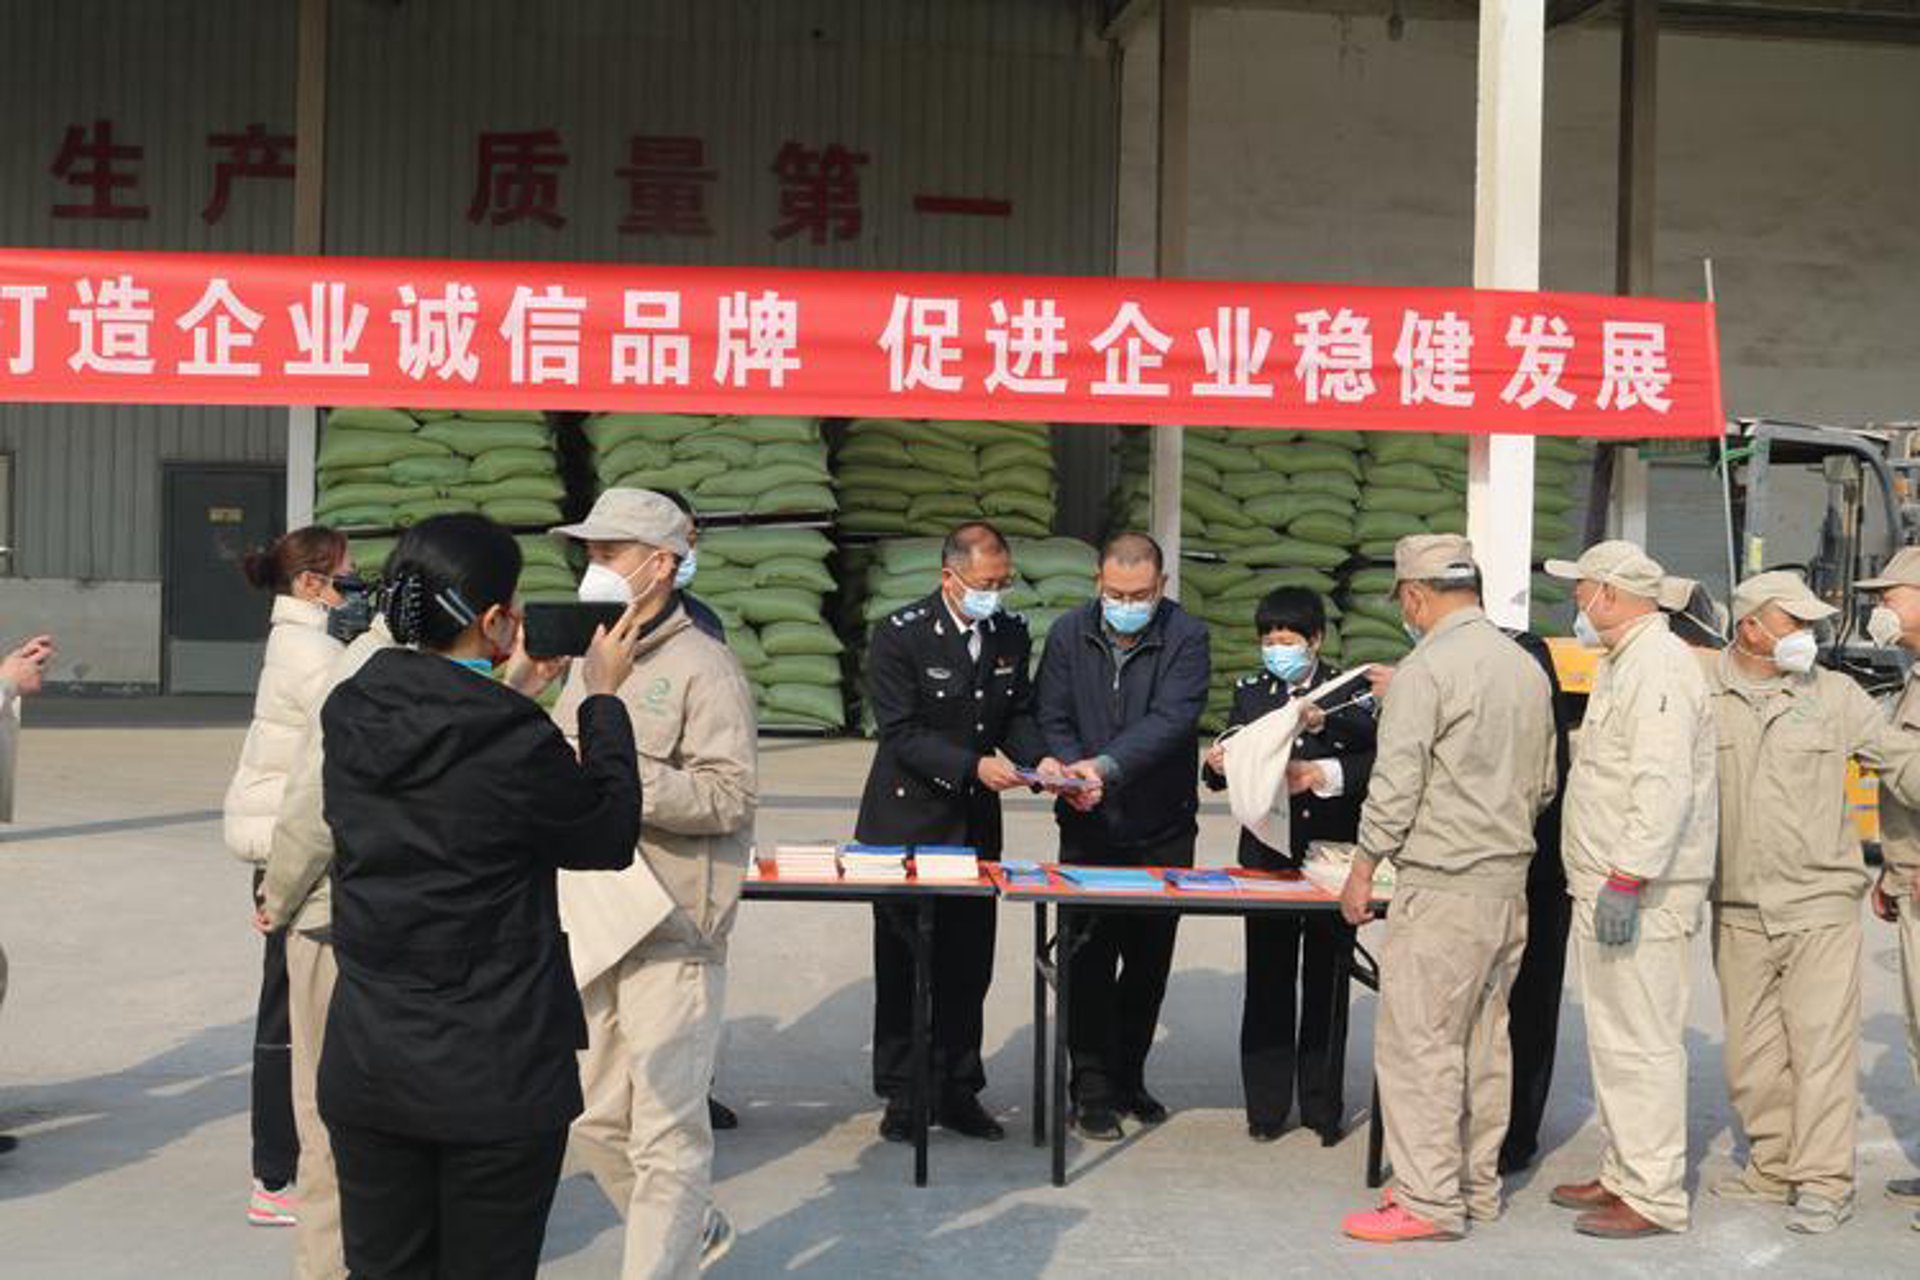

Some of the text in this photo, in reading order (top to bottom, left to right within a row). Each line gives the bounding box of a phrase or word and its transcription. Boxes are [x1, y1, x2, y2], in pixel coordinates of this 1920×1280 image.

[50, 119, 1013, 246] 生产 质量第一
[878, 293, 1674, 413] 促进企业稳健发展
